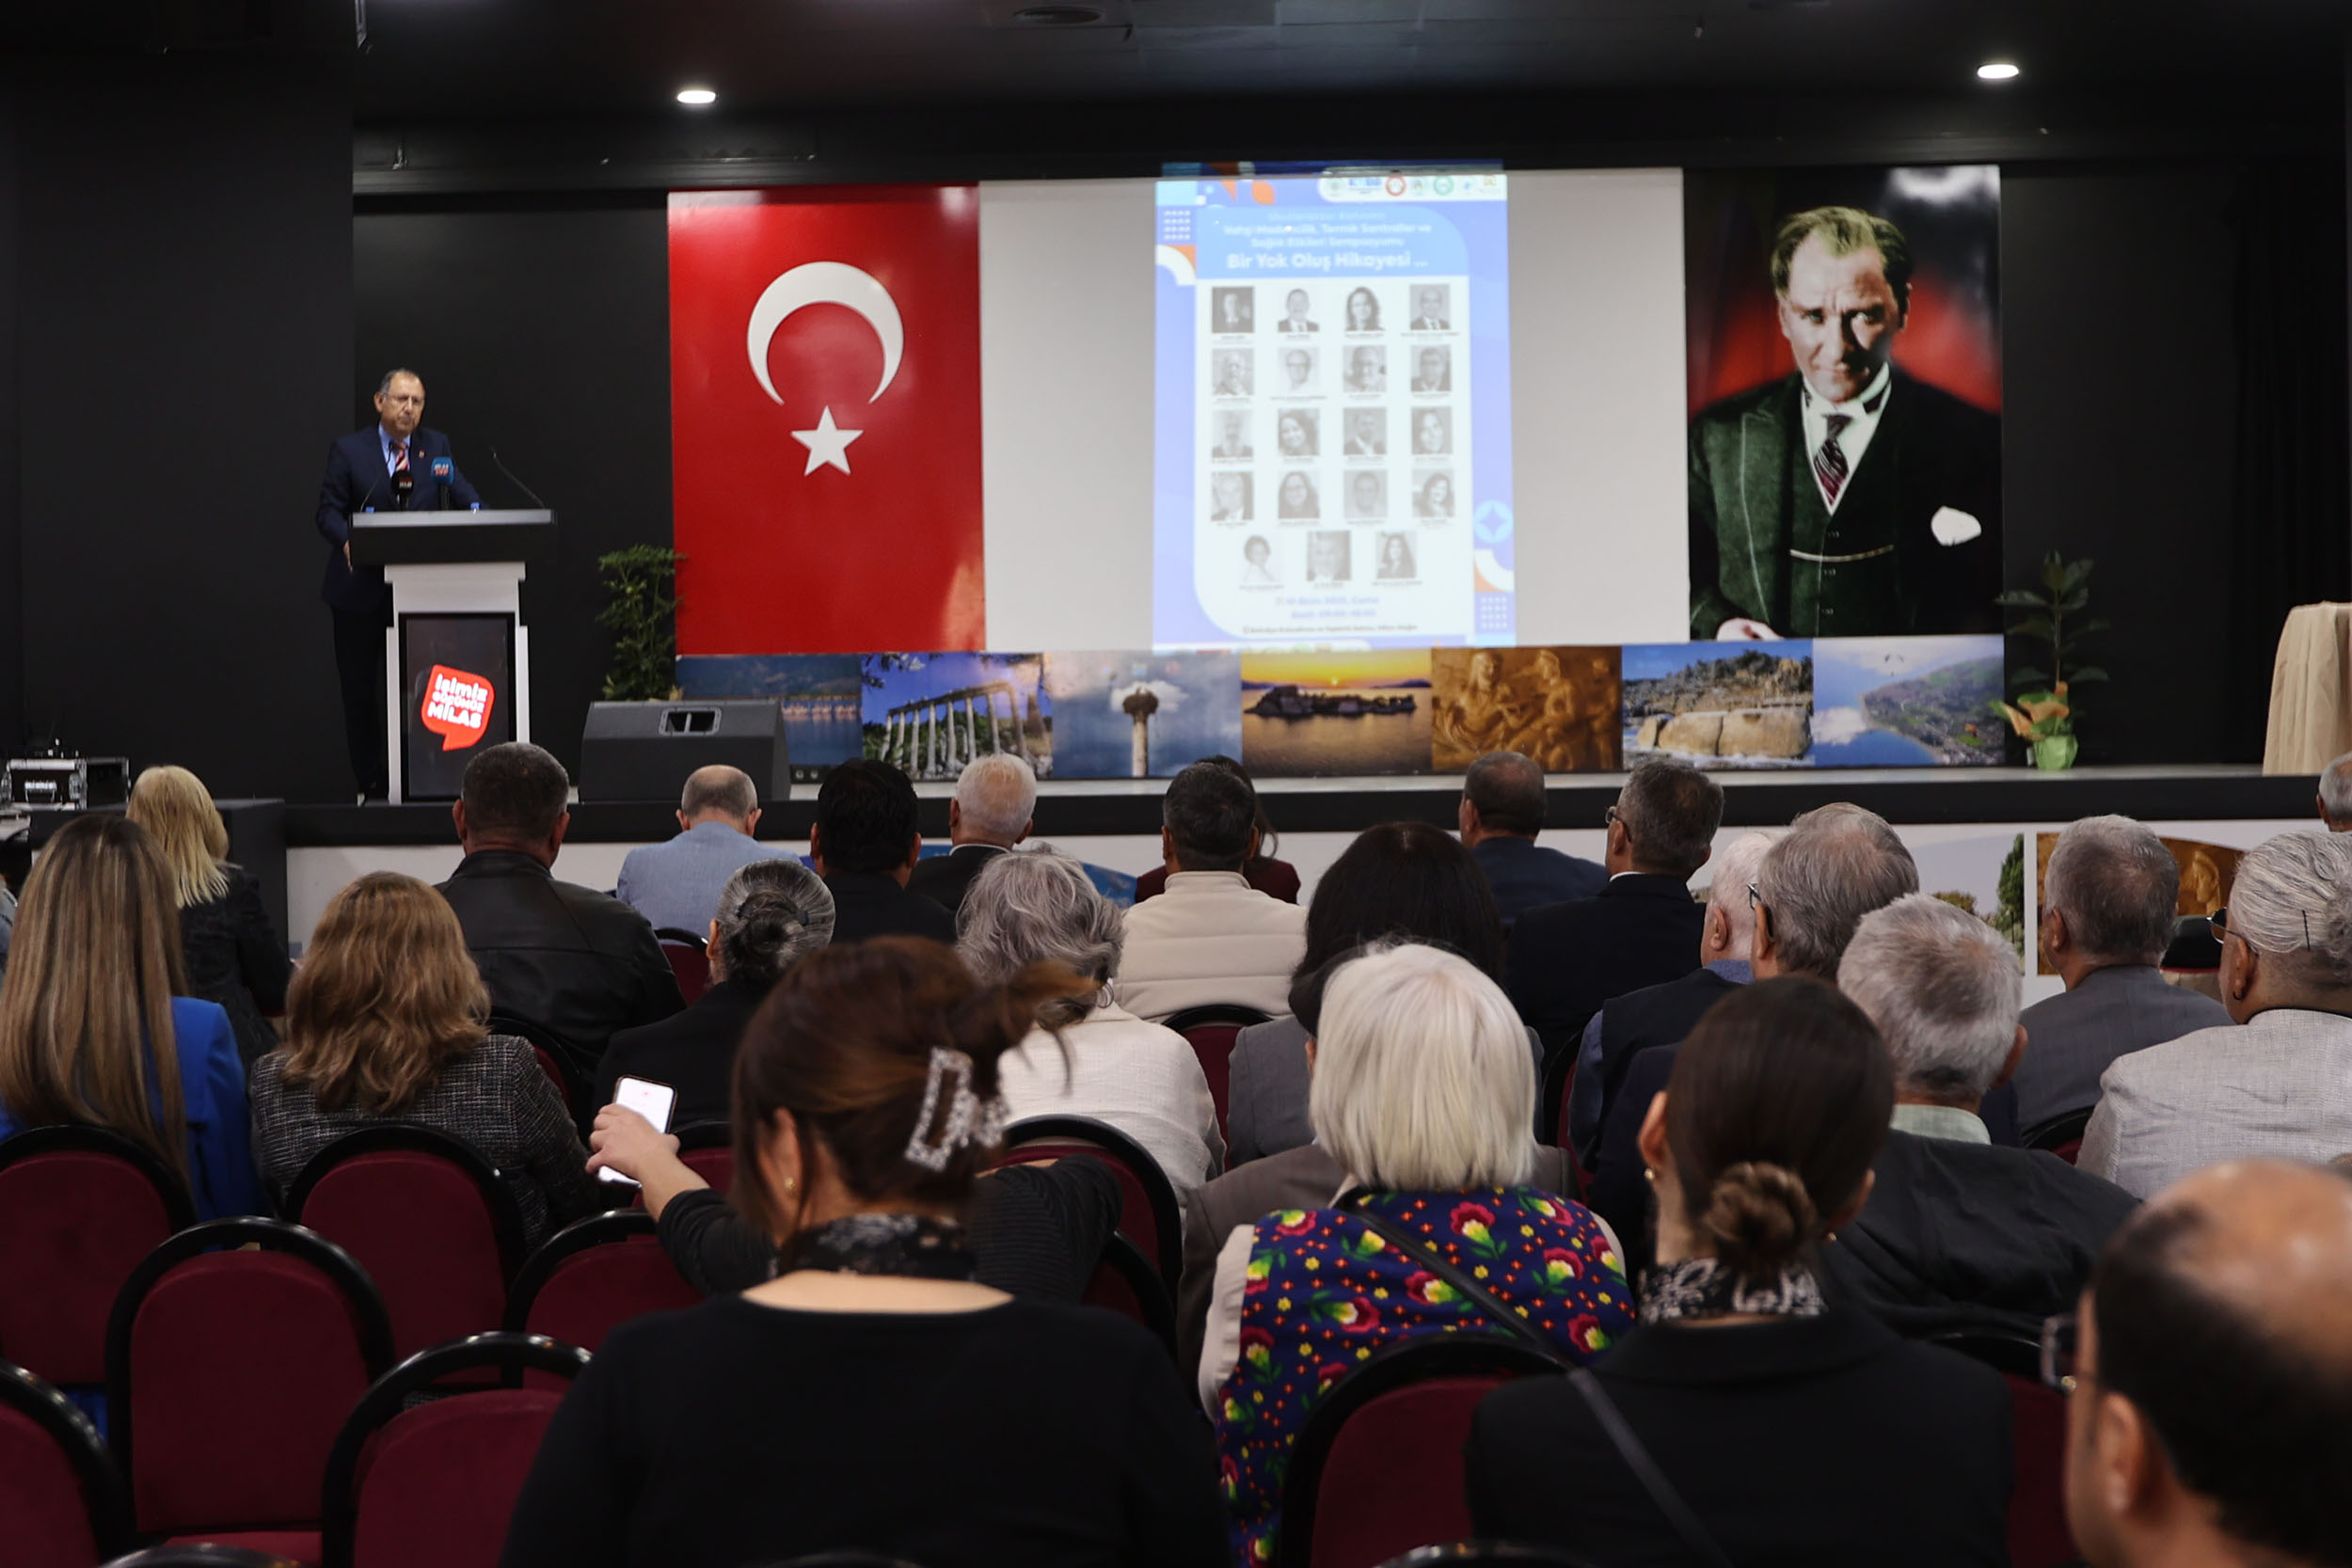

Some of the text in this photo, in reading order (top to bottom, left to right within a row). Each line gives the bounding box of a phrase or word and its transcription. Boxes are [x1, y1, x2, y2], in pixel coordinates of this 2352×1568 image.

[1227, 251, 1252, 268] Bir
[1256, 251, 1289, 268] Yok
[1292, 251, 1331, 271] Oluş
[1335, 250, 1411, 271] Hikayesi
